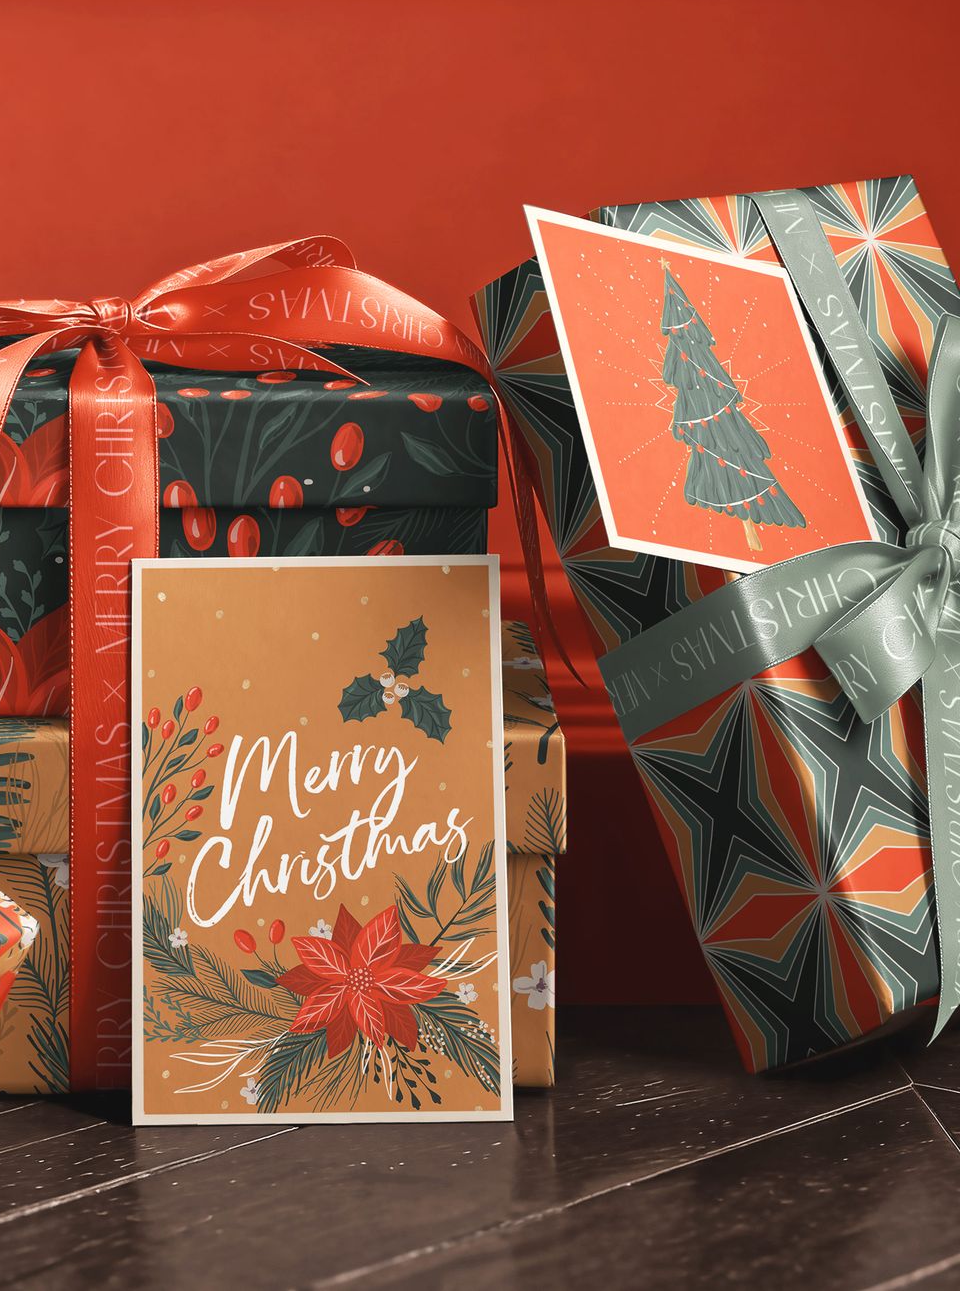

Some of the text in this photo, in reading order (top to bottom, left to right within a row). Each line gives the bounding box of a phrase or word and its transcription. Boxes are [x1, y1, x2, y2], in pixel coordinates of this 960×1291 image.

[248, 287, 444, 348] CHRISTMAS
[94, 358, 136, 497] CHRIST
[95, 516, 134, 654] MERRY
[670, 567, 878, 682] CHRISTMAS
[608, 669, 652, 718] MER
[219, 730, 420, 830] Merry
[95, 722, 133, 970] CHRISTMAS
[186, 807, 475, 928] Christmas
[95, 989, 133, 1091] ERRY
